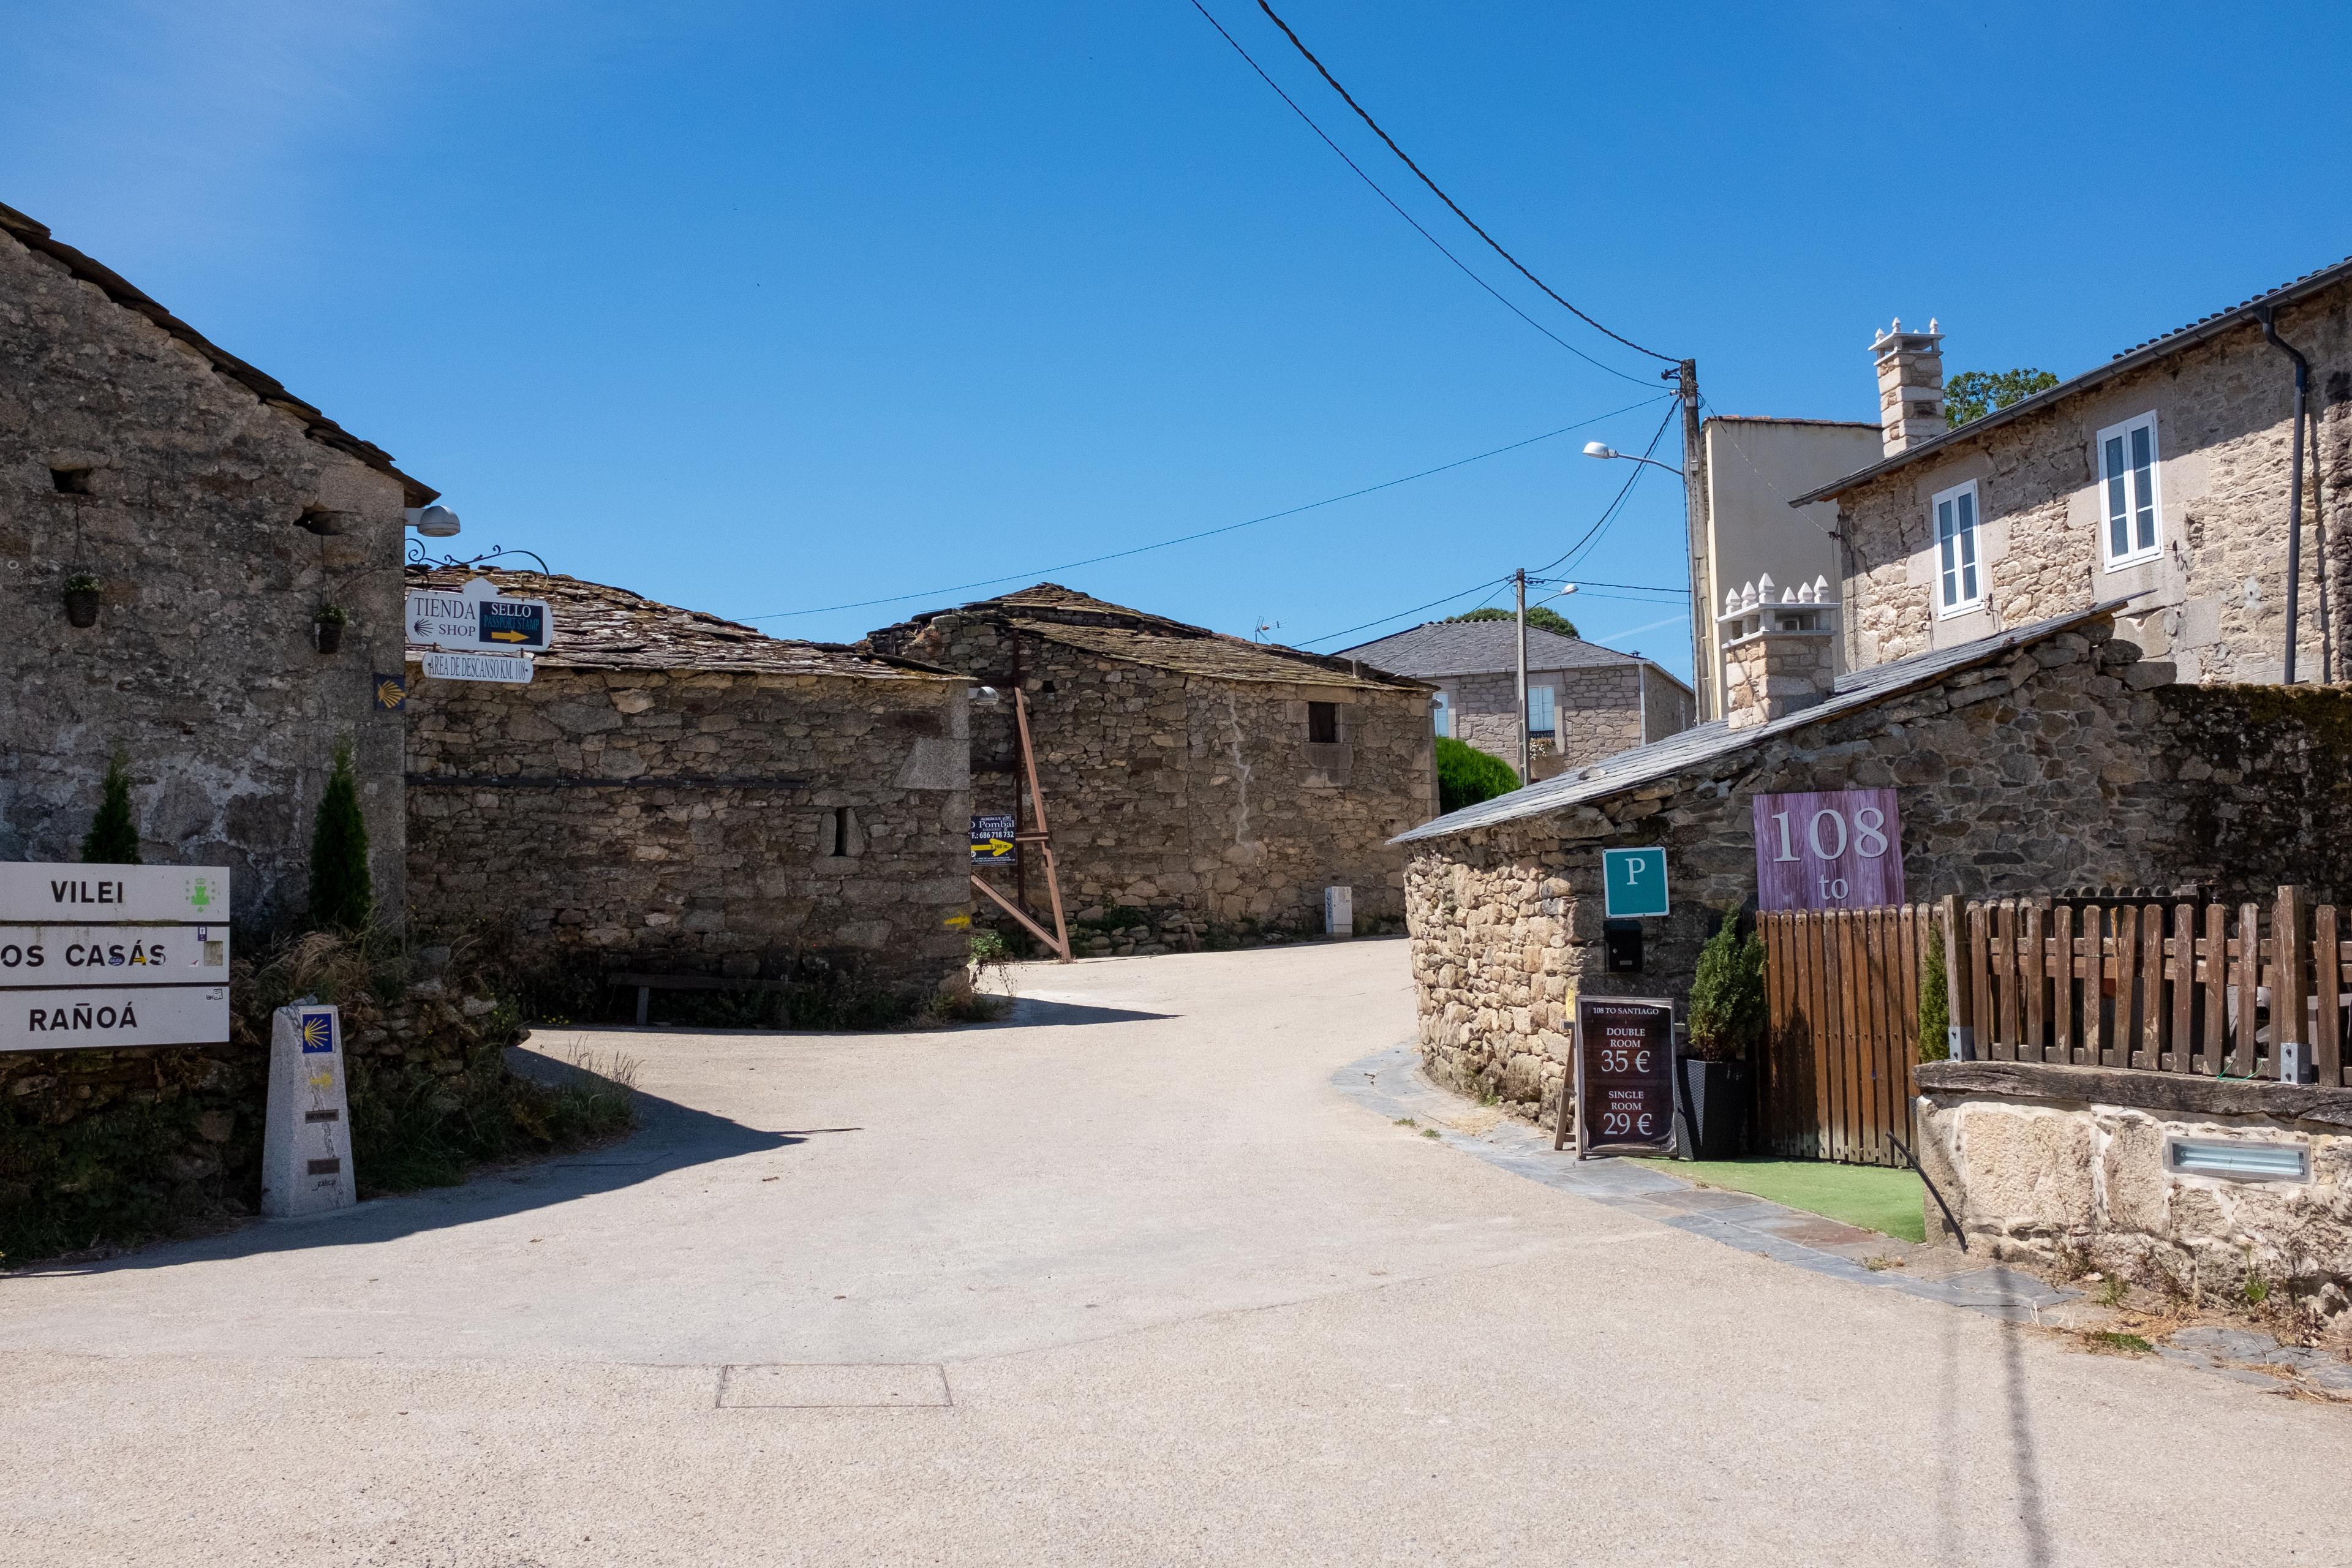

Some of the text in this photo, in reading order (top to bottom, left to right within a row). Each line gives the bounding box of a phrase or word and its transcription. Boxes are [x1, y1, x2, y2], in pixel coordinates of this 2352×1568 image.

[414, 597, 477, 620] TIENDA
[491, 603, 532, 617] SELLO
[439, 624, 476, 637] SHOP
[484, 614, 540, 631] PASSPORT STAMP
[429, 655, 526, 680] AREA DE DESCANSO KM. 108
[1771, 807, 1889, 863] 108
[1624, 857, 1646, 886] P
[51, 880, 123, 903] VILEI
[1818, 873, 1849, 900] to
[1, 939, 167, 968] OS CASÁS
[29, 1001, 138, 1031] RAÑOÁ
[1607, 1028, 1646, 1037] DOUBLE
[1610, 1039, 1641, 1048] ROOM
[1601, 1050, 1651, 1073] 35 €
[1608, 1091, 1644, 1099] SINGLE
[1604, 1112, 1653, 1136] 29 €
